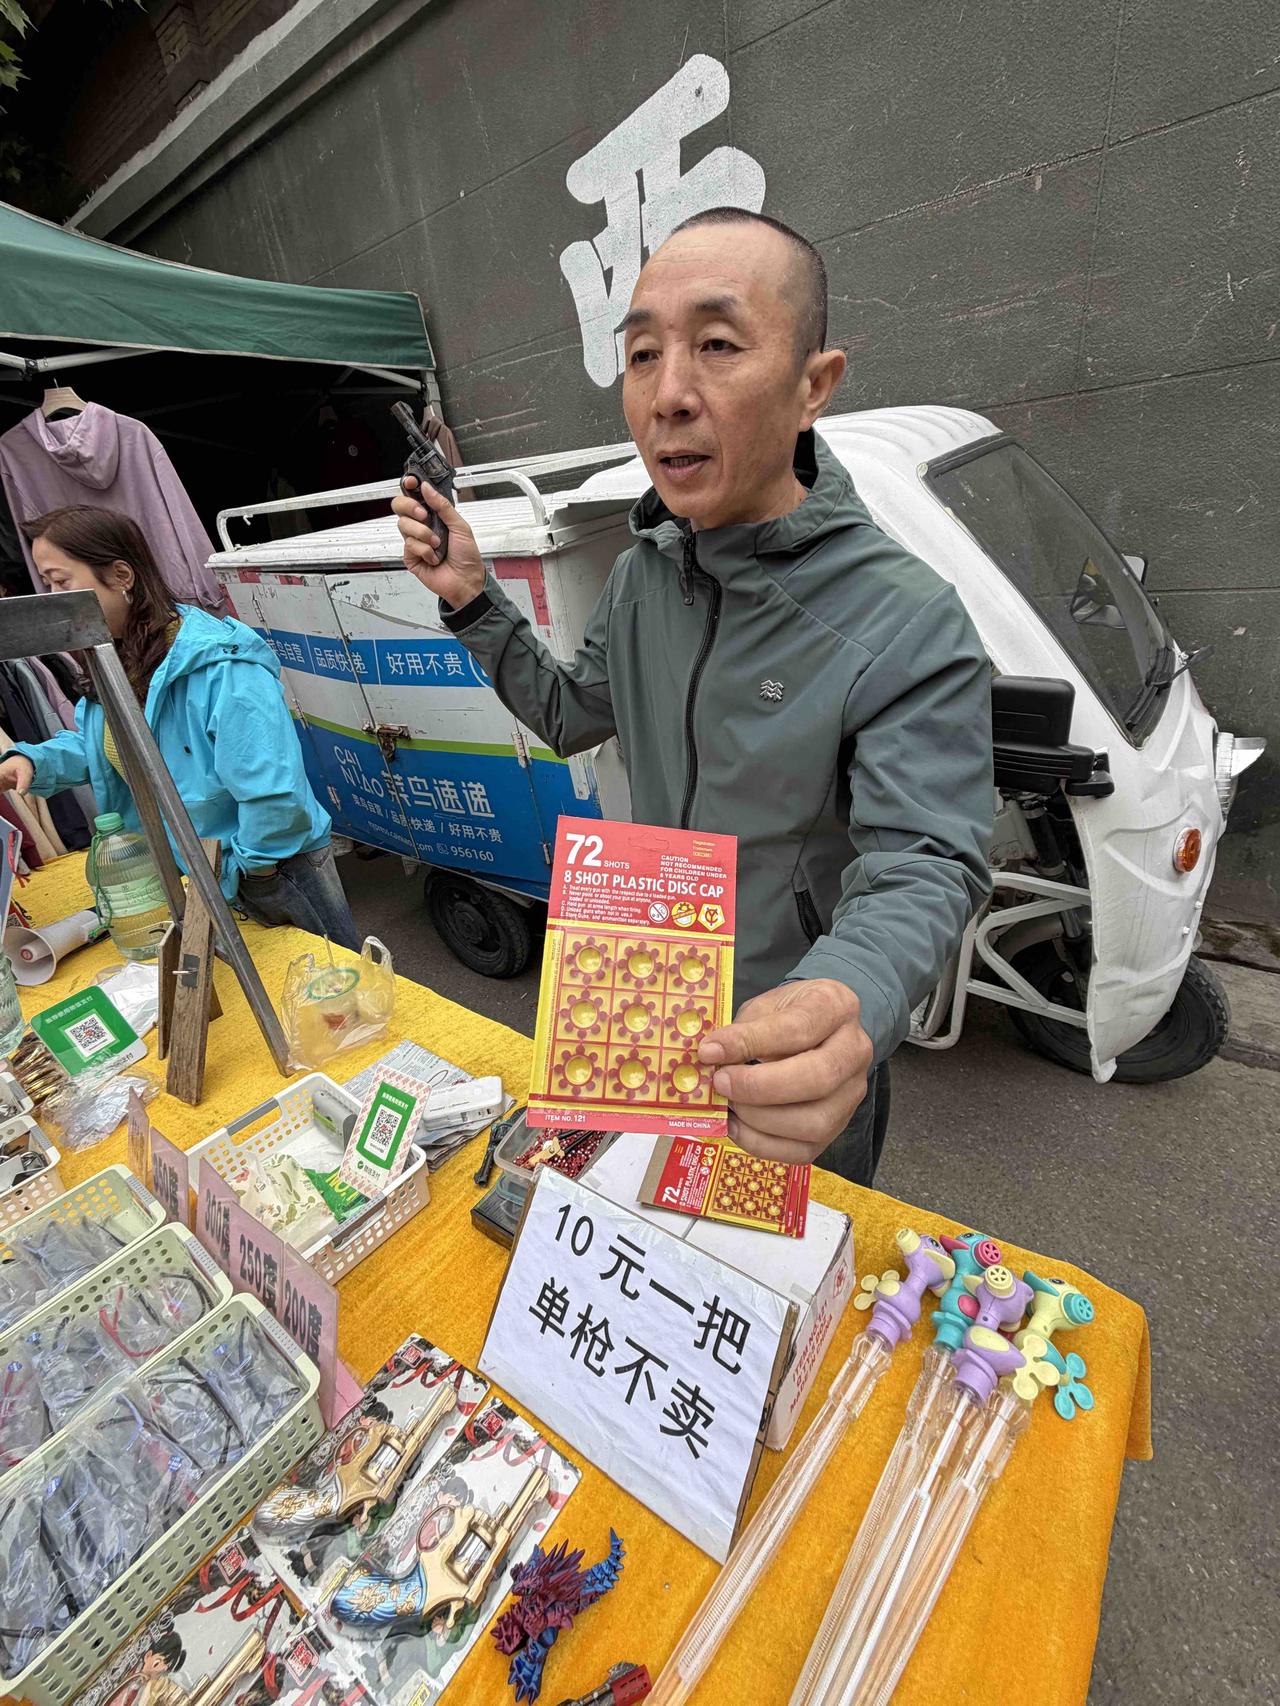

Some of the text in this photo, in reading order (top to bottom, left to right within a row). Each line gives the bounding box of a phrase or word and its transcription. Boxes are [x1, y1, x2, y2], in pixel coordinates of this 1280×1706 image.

[314, 647, 369, 674] 品质快递
[386, 651, 465, 676] 好用不贵
[382, 770, 496, 818] 菜鸟速递
[448, 821, 503, 844] 好用不贵
[450, 844, 495, 862] 956160
[565, 833, 630, 870] 72 SHOTS
[661, 854, 688, 862] CAUTION
[673, 867, 705, 876] CHILDREN
[674, 862, 722, 872] RECOMMENDED
[564, 870, 724, 898] 8 SHOT PLASTIC DISC CAP
[574, 1115, 586, 1123] 121
[662, 1186, 681, 1204] 72
[239, 1233, 279, 1314] 250度
[554, 1204, 751, 1375] 10元一把
[283, 1278, 323, 1366] 200度
[528, 1277, 715, 1460] 单枪不卖
